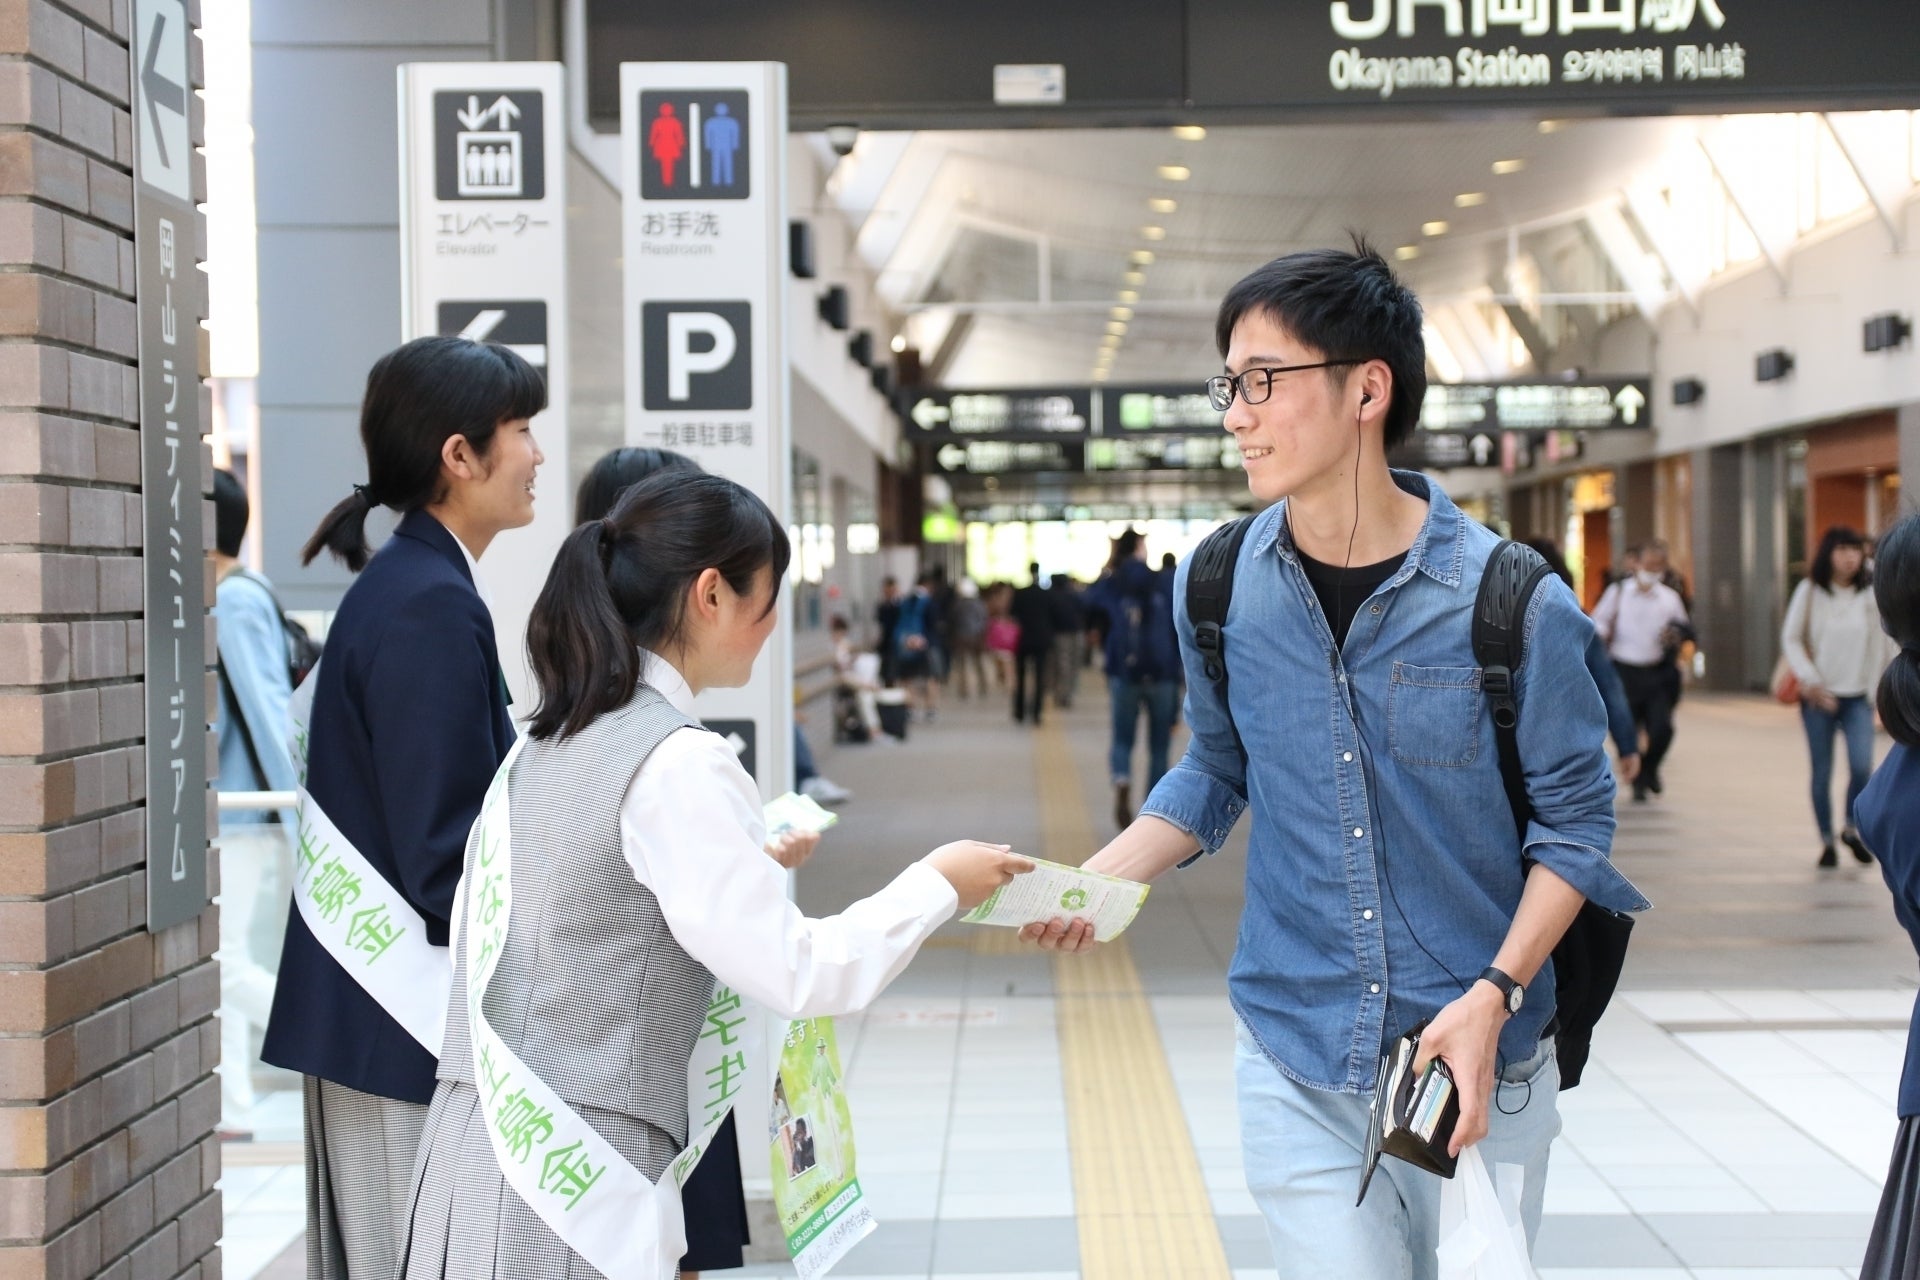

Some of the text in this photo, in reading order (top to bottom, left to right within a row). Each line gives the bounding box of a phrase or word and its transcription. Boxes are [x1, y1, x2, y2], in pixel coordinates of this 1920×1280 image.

[1329, 46, 1551, 98] Okayama Station
[435, 212, 550, 236] エレベーター
[641, 211, 720, 237] お手洗
[435, 241, 497, 255] Elevator
[641, 241, 714, 255] Restroom
[667, 311, 737, 401] P
[643, 421, 753, 447] 一般車駐車場
[159, 217, 187, 882] 岡山シティミュージアム
